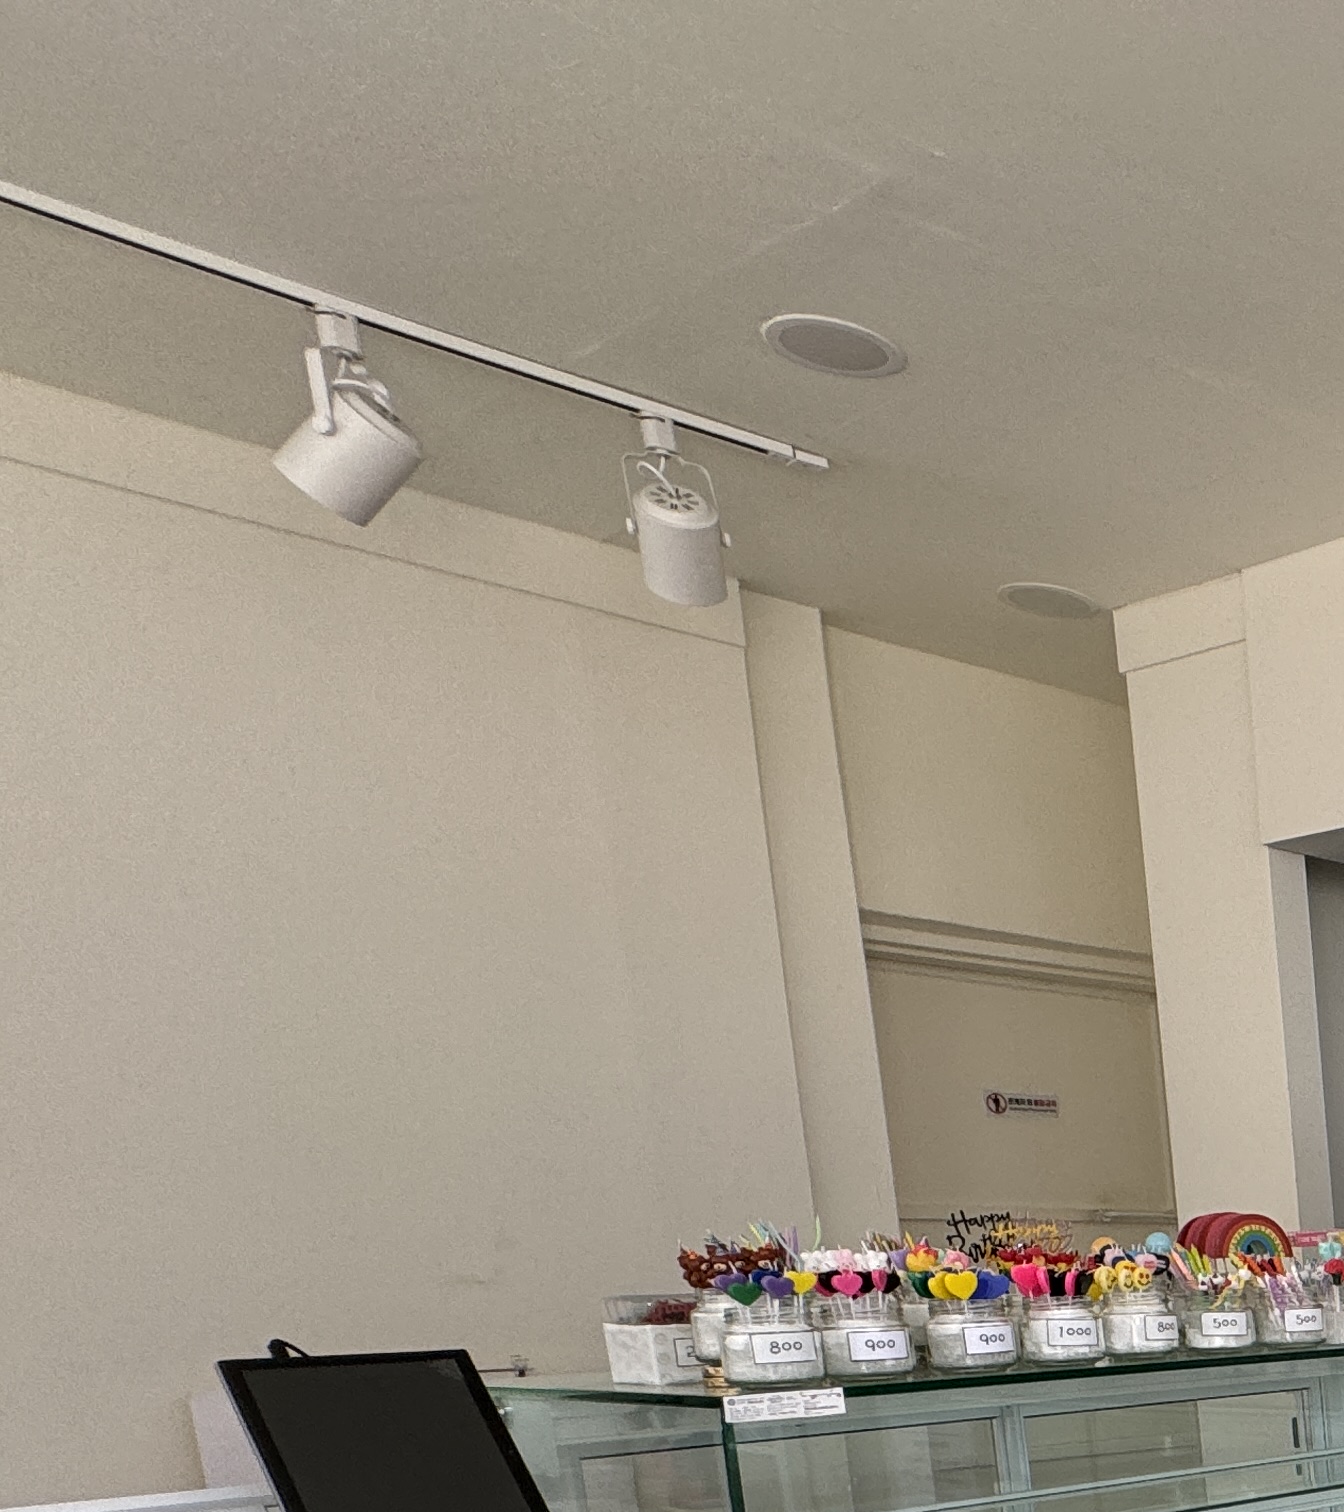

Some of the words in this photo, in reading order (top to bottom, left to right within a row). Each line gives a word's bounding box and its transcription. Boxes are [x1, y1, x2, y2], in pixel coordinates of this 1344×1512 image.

[946, 1209, 1010, 1235] Happy
[1212, 1317, 1238, 1329] 500
[1295, 1313, 1317, 1325] 500
[1058, 1326, 1092, 1338] 1000
[1157, 1321, 1175, 1333] 800
[864, 1338, 896, 1352] 900
[979, 1332, 1006, 1346] 900
[769, 1340, 803, 1355] 800
